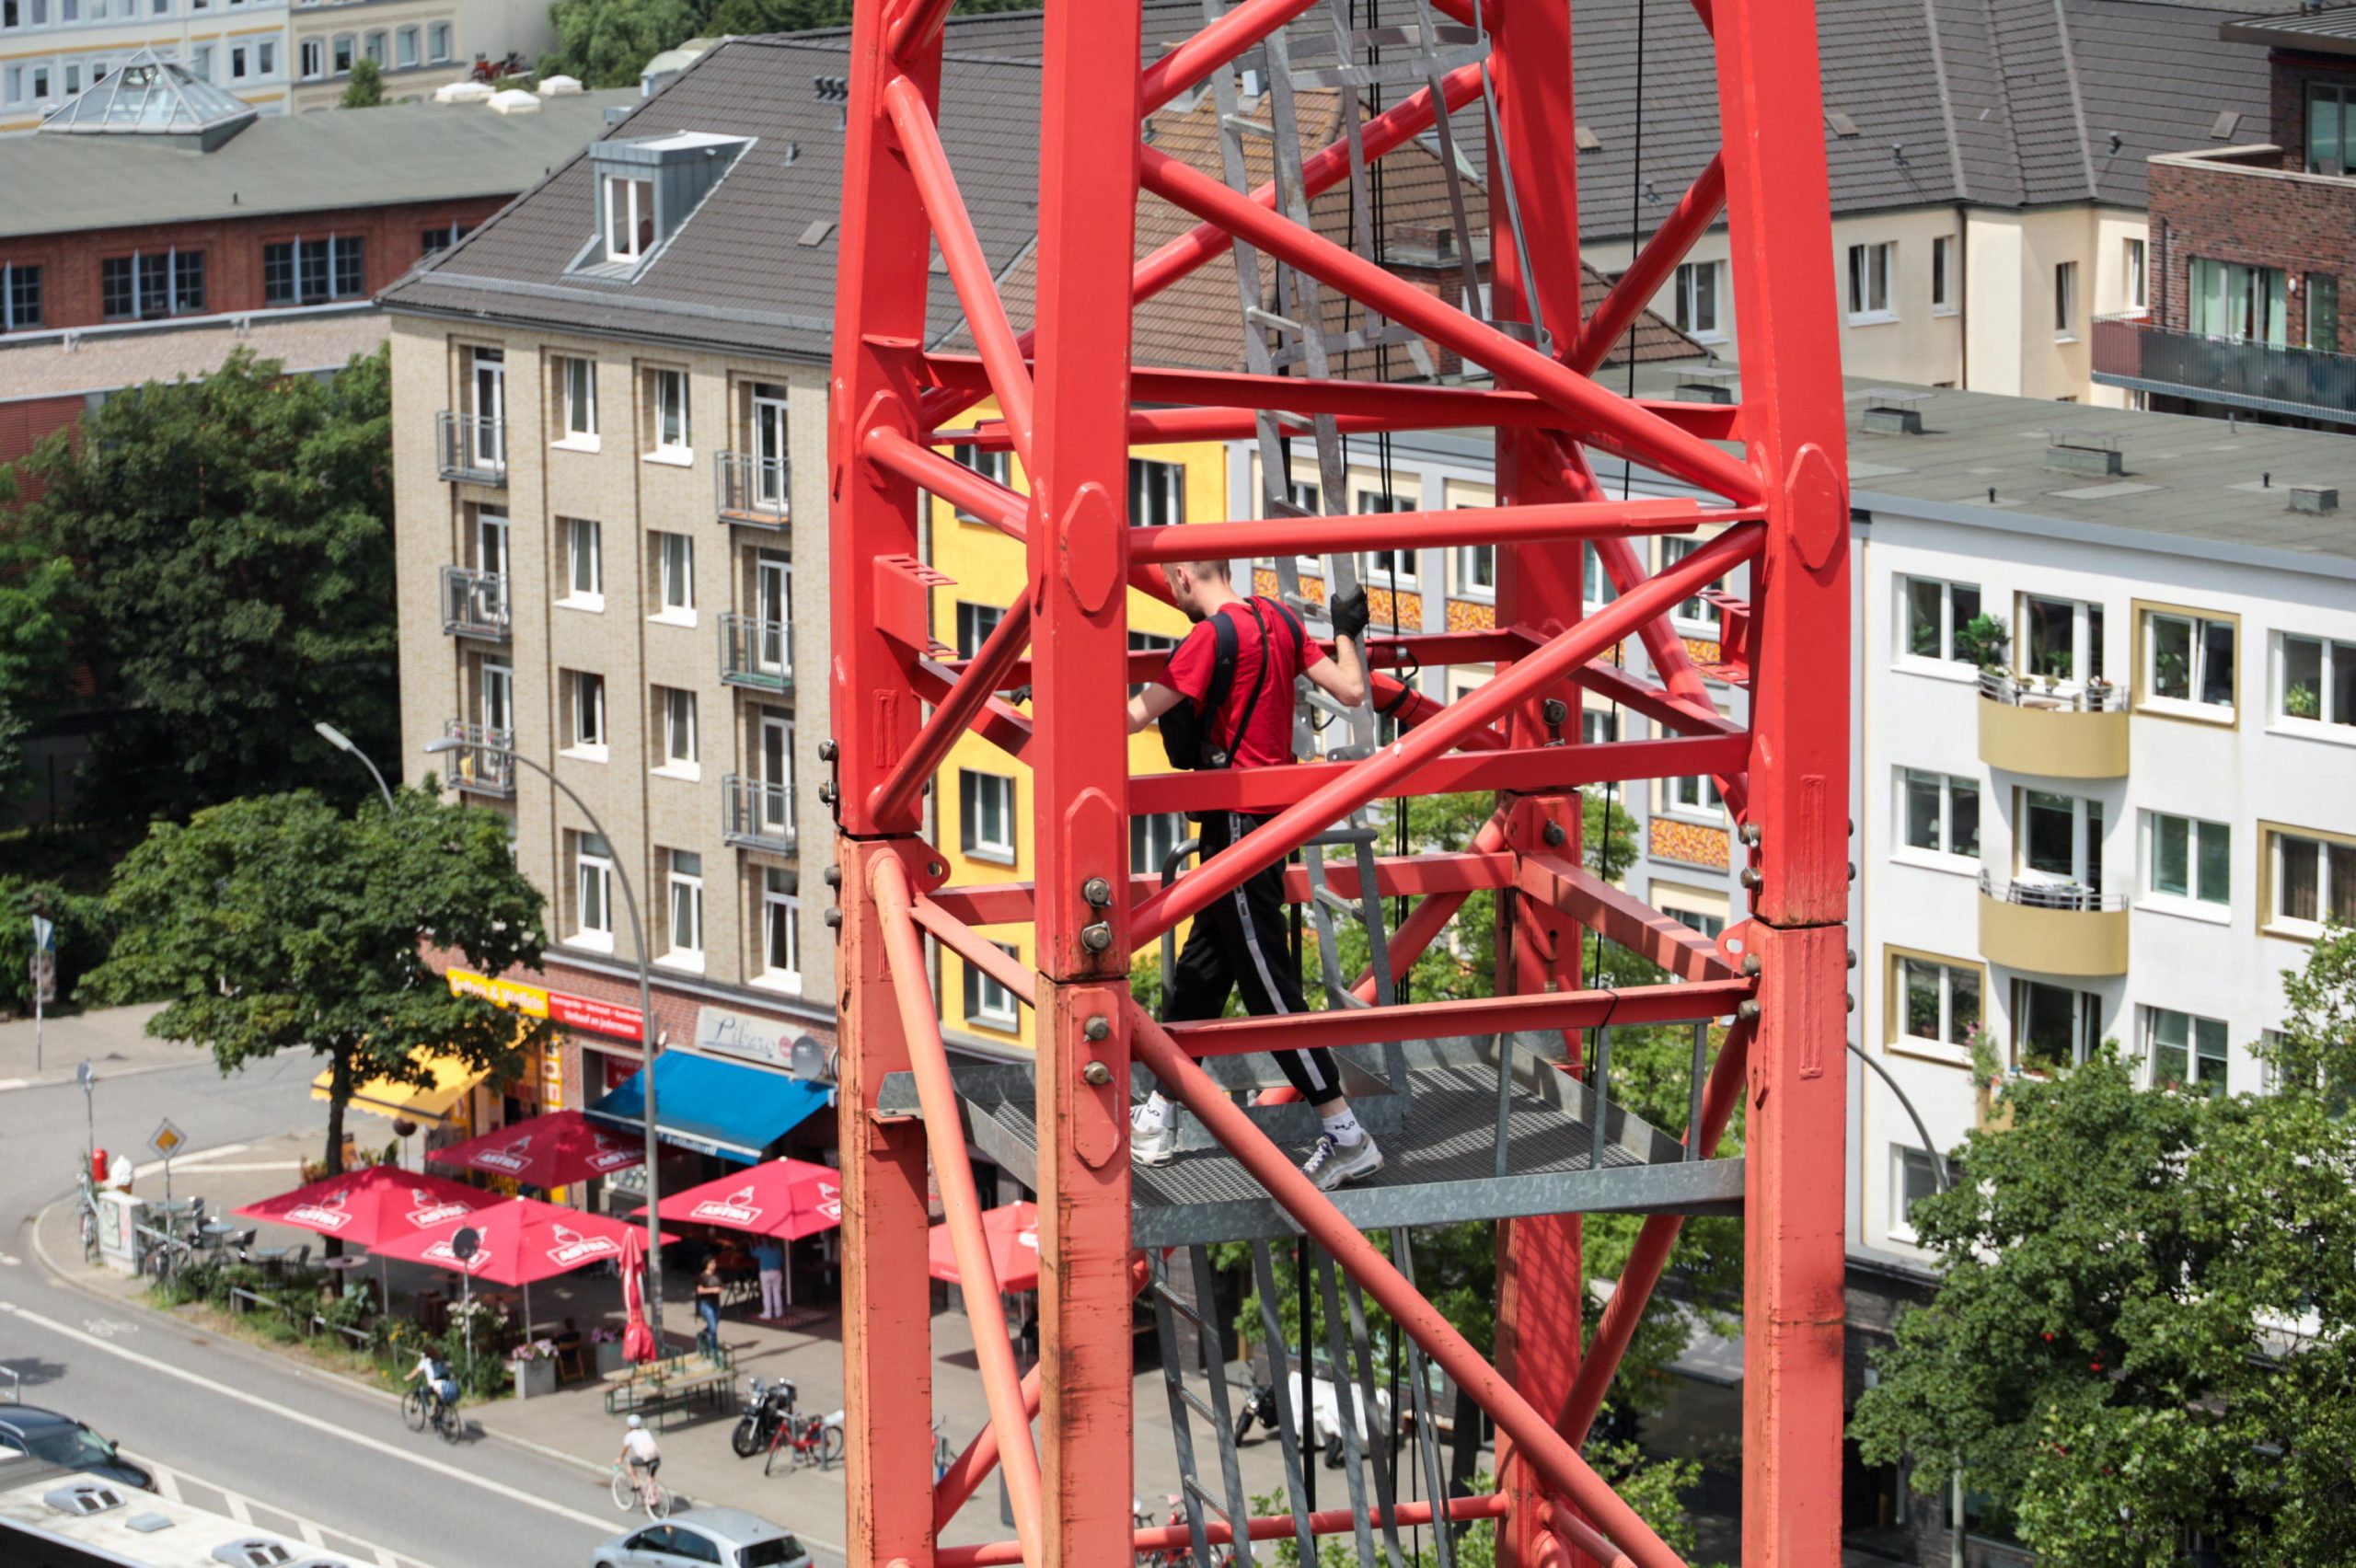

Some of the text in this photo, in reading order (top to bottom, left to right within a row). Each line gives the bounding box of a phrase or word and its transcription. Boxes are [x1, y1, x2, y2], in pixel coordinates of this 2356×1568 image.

[479, 1153, 523, 1170] ASTRA
[293, 1208, 341, 1227] ASTRA
[418, 1205, 468, 1225] ASTRA
[700, 1205, 751, 1221] ASTRA
[559, 1240, 611, 1262] ASTRA
